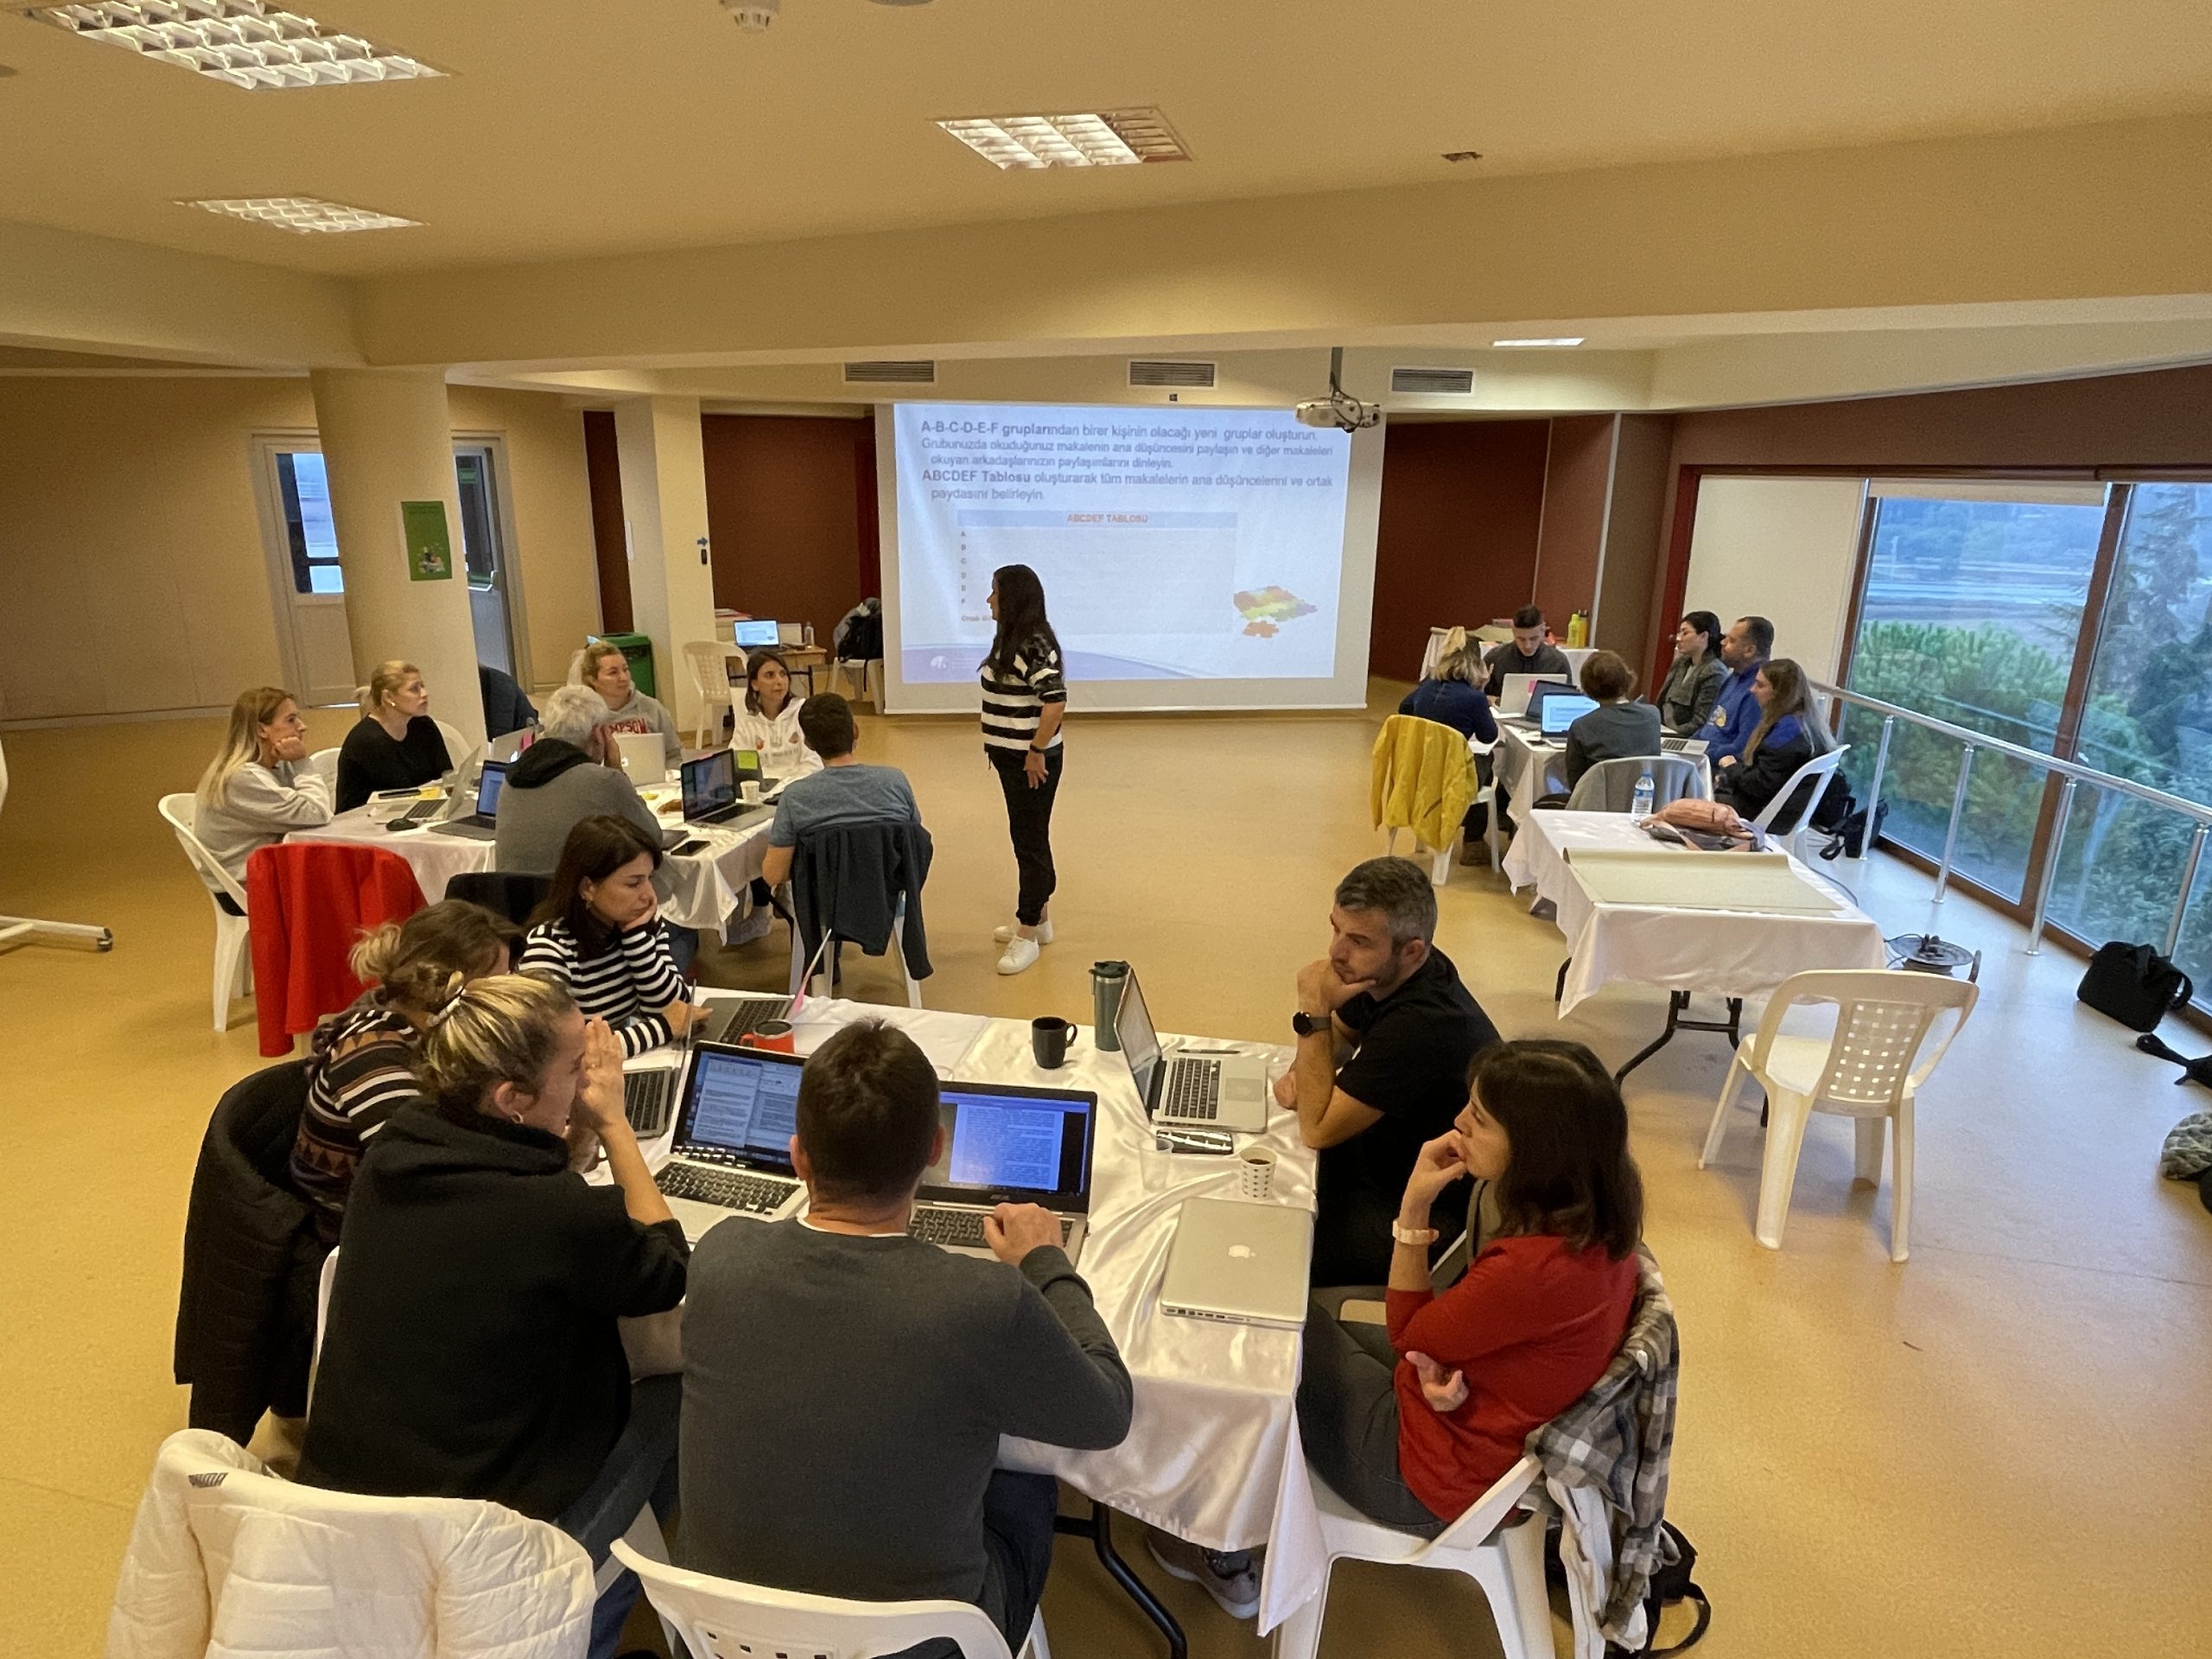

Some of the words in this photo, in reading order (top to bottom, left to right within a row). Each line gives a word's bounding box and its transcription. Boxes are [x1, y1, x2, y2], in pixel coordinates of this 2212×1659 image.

[921, 421, 999, 433] A-B-C-D-E-F
[1002, 423, 1079, 436] gruplarından
[1083, 423, 1109, 435] birer
[1111, 425, 1147, 439] kişinin
[1150, 426, 1191, 440] olacağı
[1194, 428, 1217, 441] yeni
[1224, 429, 1262, 442] gruplar
[921, 437, 987, 450] Grubunuzda
[990, 439, 1054, 452] okuduğunuz
[1057, 441, 1109, 452] makalenin
[1112, 443, 1132, 453] ana
[1135, 442, 1194, 455] düşüncesini
[1197, 443, 1238, 456] paylaşın
[1242, 446, 1253, 454] ve
[1255, 445, 1281, 457] diğer
[1283, 445, 1333, 455] makaleleri
[931, 454, 969, 467] okuyan
[972, 455, 1055, 468] arkadaşlarınızın
[1058, 456, 1129, 469] paylaşımlarını
[922, 470, 977, 481] ABCDEF
[982, 470, 1031, 483] Tablosu
[1034, 472, 1097, 486] oluşturarak
[1101, 474, 1122, 484] tüm
[1125, 474, 1189, 485] makalelerin
[1192, 476, 1212, 486] ana
[1216, 475, 1287, 488] düşüncelerini
[1291, 477, 1303, 486] ve
[1306, 476, 1333, 486] ortak
[931, 488, 988, 501] paydasını
